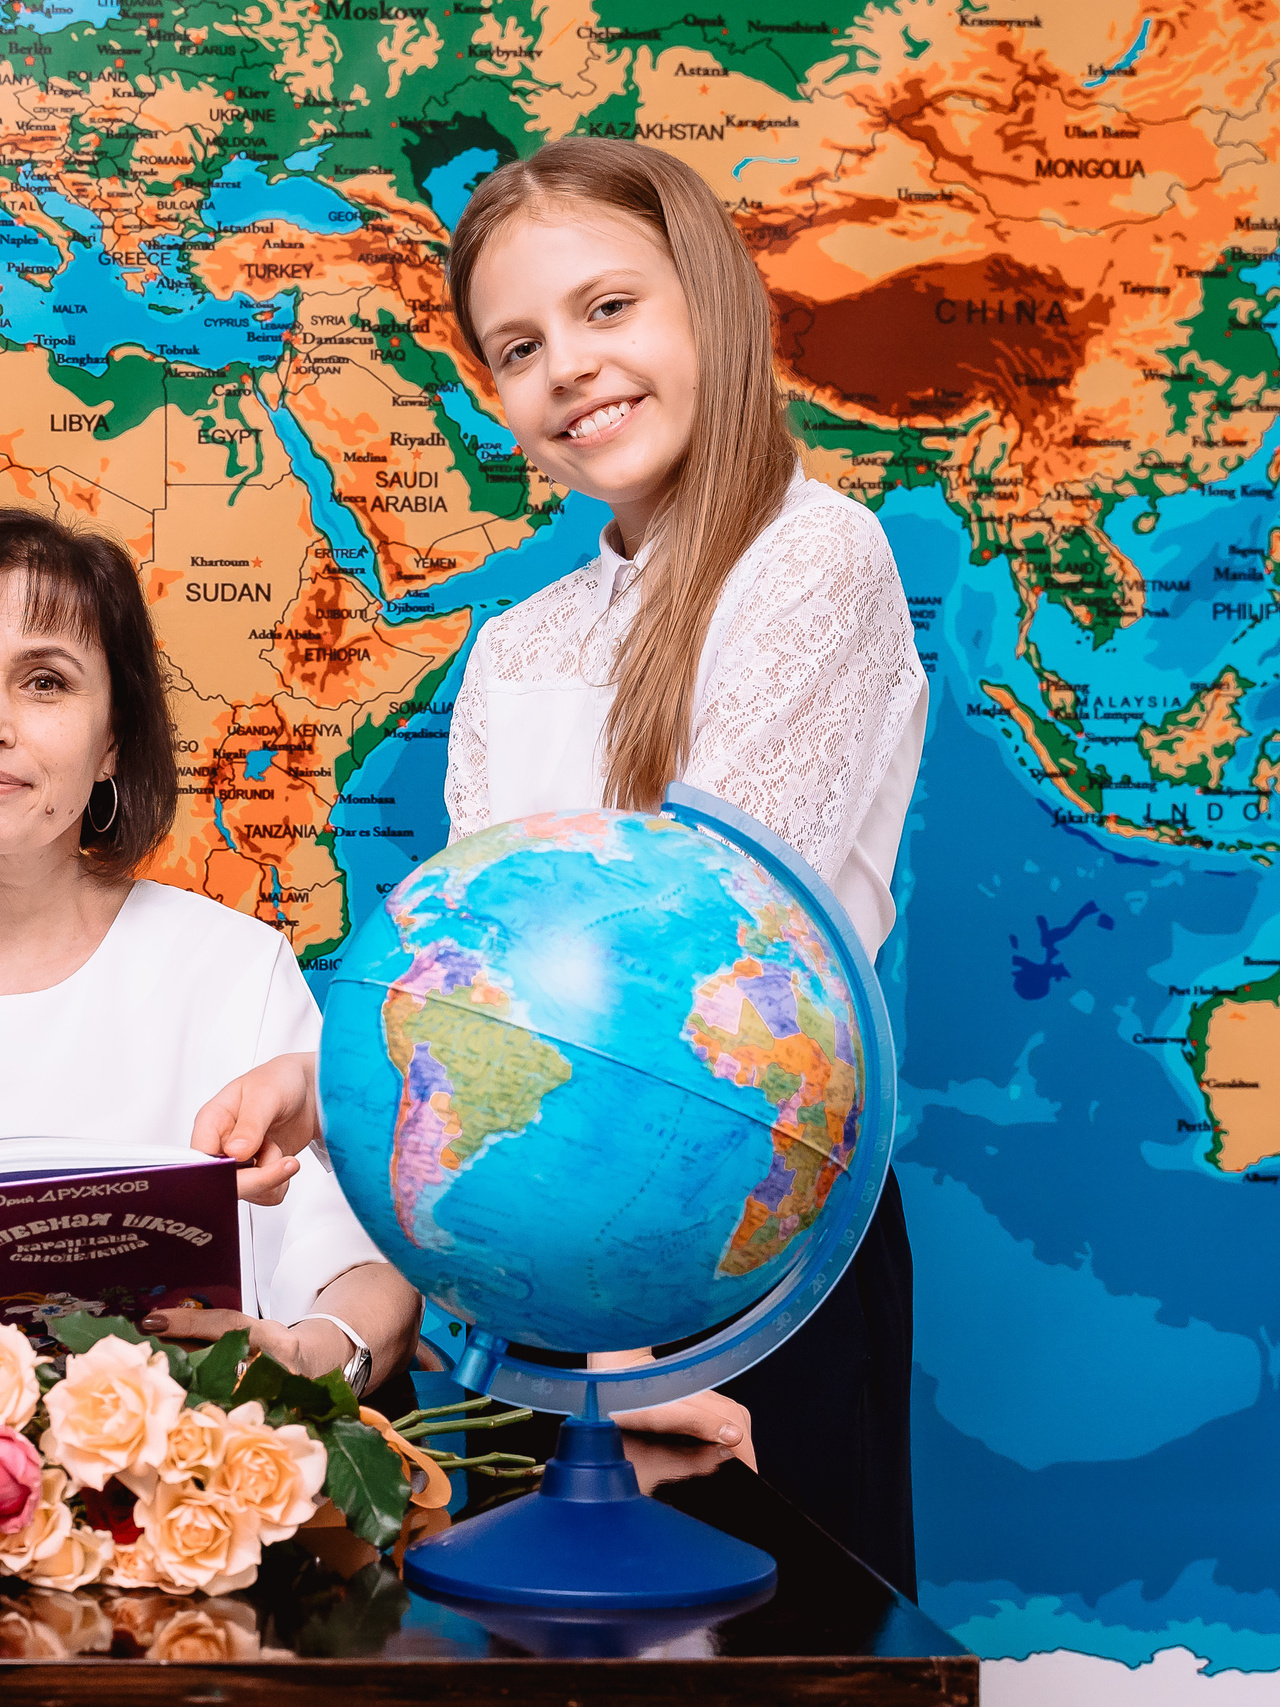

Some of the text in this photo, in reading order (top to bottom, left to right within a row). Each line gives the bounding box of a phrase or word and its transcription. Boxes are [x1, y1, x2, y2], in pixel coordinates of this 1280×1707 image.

[326, 1, 429, 20] Moskow
[9, 43, 52, 56] Berlin
[675, 63, 728, 77] Astana
[68, 71, 128, 83] POLAND
[238, 87, 268, 99] Kiev
[210, 108, 276, 123] UKRAINE
[725, 115, 800, 129] Karaganda
[589, 122, 724, 140] KAZAKHSTAN
[1036, 159, 1145, 178] MONGOLIA
[216, 222, 274, 234] Istanbul
[0, 235, 39, 246] Naples
[98, 253, 171, 266] GREECE
[244, 264, 314, 278] TURKEY
[935, 300, 1068, 324] CHINA
[360, 318, 430, 336] Baghdad
[34, 335, 75, 347] Tripoli
[302, 333, 374, 345] Damascus
[157, 345, 200, 355] Tobruk
[371, 350, 406, 362] IRAQ
[212, 384, 251, 397] Cairo
[50, 415, 110, 433] LIBYA
[198, 429, 262, 445] EGYPT
[390, 432, 446, 447] Riyadh
[343, 452, 387, 463] Medina
[375, 471, 438, 488] SAUDI
[371, 496, 448, 513] ARABIA
[190, 557, 250, 568] Khartoum
[414, 558, 456, 569] YEMEN
[186, 583, 271, 602] SUDAN
[1126, 580, 1190, 592] VIETNAM
[387, 601, 434, 614] Djibouti
[248, 629, 321, 640] Addis Ababa
[304, 649, 370, 661] ETHIOPIA
[389, 702, 454, 714] SOMALIA
[1077, 697, 1182, 707] MALAYSIA
[293, 725, 342, 737] KENYA
[219, 789, 274, 800] BURUNDI
[339, 795, 395, 805] Mombasa
[244, 824, 318, 838] TANZANIA
[335, 827, 414, 838] Dar es Salaam
[1177, 1119, 1211, 1132] Perth
[37, 1180, 149, 1204] ДРУЖКОВ
